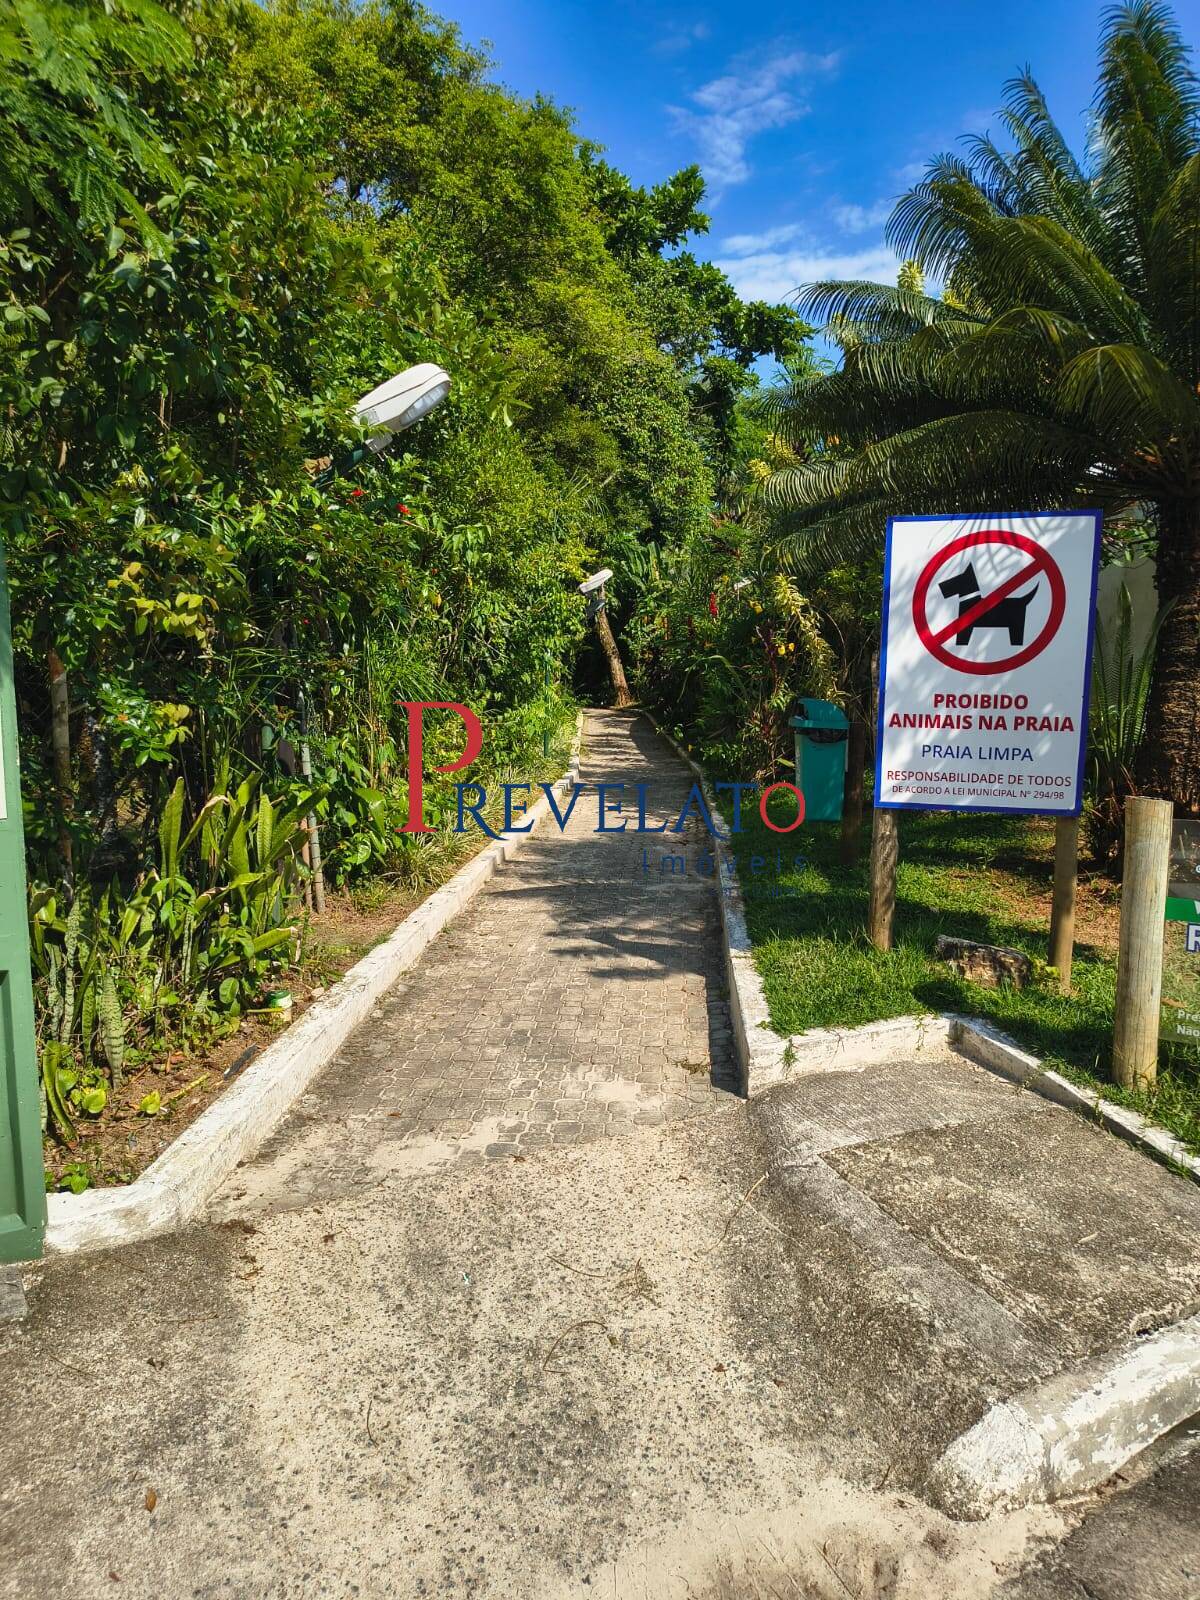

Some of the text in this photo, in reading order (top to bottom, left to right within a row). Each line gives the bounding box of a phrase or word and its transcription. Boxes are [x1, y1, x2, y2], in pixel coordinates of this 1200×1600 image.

[933, 693, 1028, 709] PROIBIDO
[889, 713, 1074, 732] ANIMAIS NA PRAIA
[922, 744, 1033, 762] PRAIA LIMPA
[887, 770, 1072, 787] RESPONSABILIDADE DE TODOS
[892, 785, 903, 793] DE
[905, 785, 941, 795] ACORDO
[944, 786, 950, 795] A
[952, 786, 965, 796] LEI
[967, 787, 1017, 798] MUNICIPAL
[1034, 790, 1064, 799] 294/98
[1177, 1009, 1200, 1022] Pre
